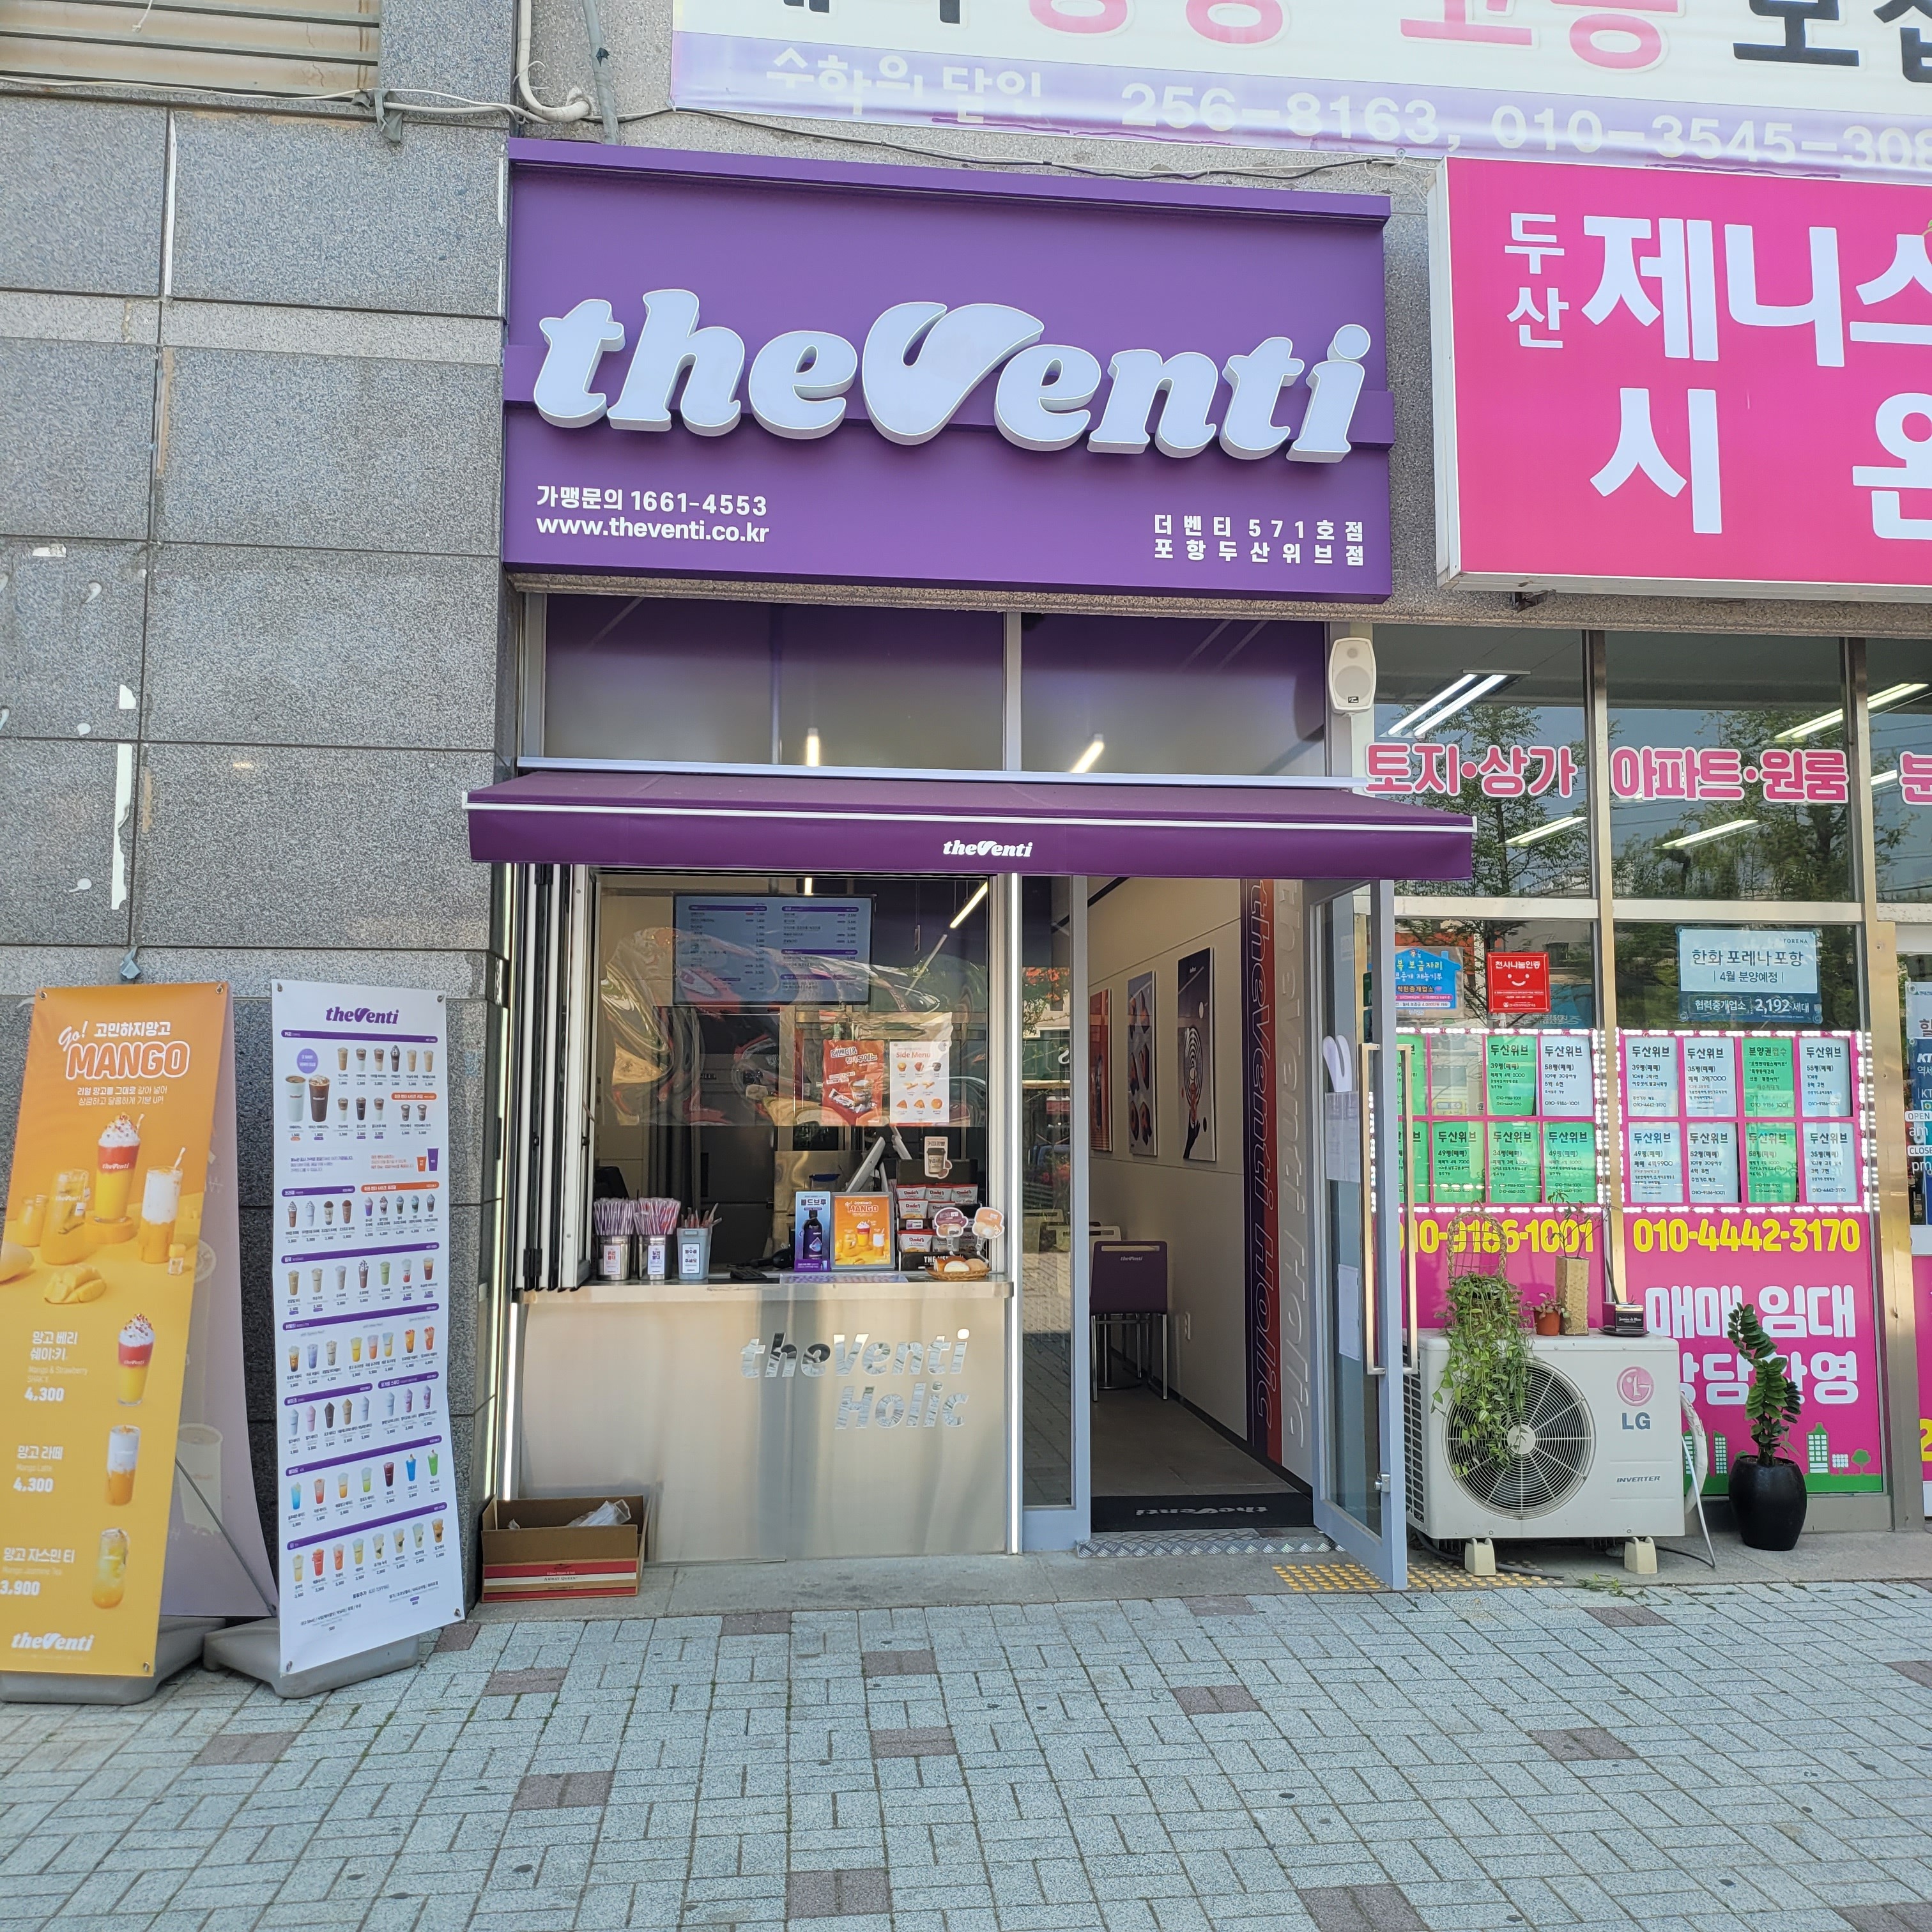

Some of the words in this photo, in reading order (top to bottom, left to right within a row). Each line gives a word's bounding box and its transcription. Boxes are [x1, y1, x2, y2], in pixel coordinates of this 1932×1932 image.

[533, 288, 1368, 463] theVenti
[537, 486, 623, 510] 가맹문의
[631, 491, 767, 516] 1661-4553
[536, 516, 770, 543] www.theventi.co.kr
[942, 839, 1033, 857] theVenti
[1495, 960, 1540, 969] 천사나눔인증
[1691, 949, 1724, 965] 한화
[1726, 950, 1772, 967] 포레나
[1774, 951, 1804, 967] 포항
[1407, 960, 1443, 971] 보금자리
[1719, 970, 1736, 983] 4월
[1738, 971, 1777, 983] 분양예정
[1694, 999, 1747, 1011] 협력중개업소
[1754, 999, 1790, 1014] 2,192
[1792, 1002, 1809, 1013] 세대
[325, 1006, 399, 1025] theVenti
[94, 1021, 171, 1038] 고민하지망고
[1491, 1044, 1529, 1056] 두산위브
[1544, 1045, 1583, 1057] 두산위브
[1632, 1046, 1670, 1057] 두산위브
[1687, 1048, 1724, 1059] 두산위브
[1806, 1046, 1841, 1058] 두산위브
[65, 1040, 191, 1080] MANGO
[1438, 1131, 1476, 1143] 두산위브
[1493, 1131, 1531, 1143] 두산위브
[1549, 1131, 1588, 1143] 두산위브
[1634, 1132, 1671, 1144] 두산위브
[1690, 1132, 1728, 1144] 두산위브
[1749, 1132, 1787, 1144] 두산위브
[1810, 1132, 1848, 1144] 두산위브
[1908, 1126, 1928, 1137] am
[1912, 1161, 1931, 1174] pm
[847, 1204, 879, 1213] MANGO
[1633, 1218, 1860, 1253] 010-4442-3170
[1758, 1284, 1857, 1338] 임대
[33, 1331, 54, 1344] 망고
[56, 1331, 78, 1345] 베리
[740, 1328, 970, 1378] theVenti
[834, 1381, 969, 1429] Holic
[1621, 1412, 1651, 1430] LG
[17, 1445, 39, 1459] 망고
[41, 1446, 63, 1460] 라떼
[3, 1547, 26, 1561] 망고
[27, 1548, 61, 1563] 자스민
[11, 1632, 95, 1652] theVenti
